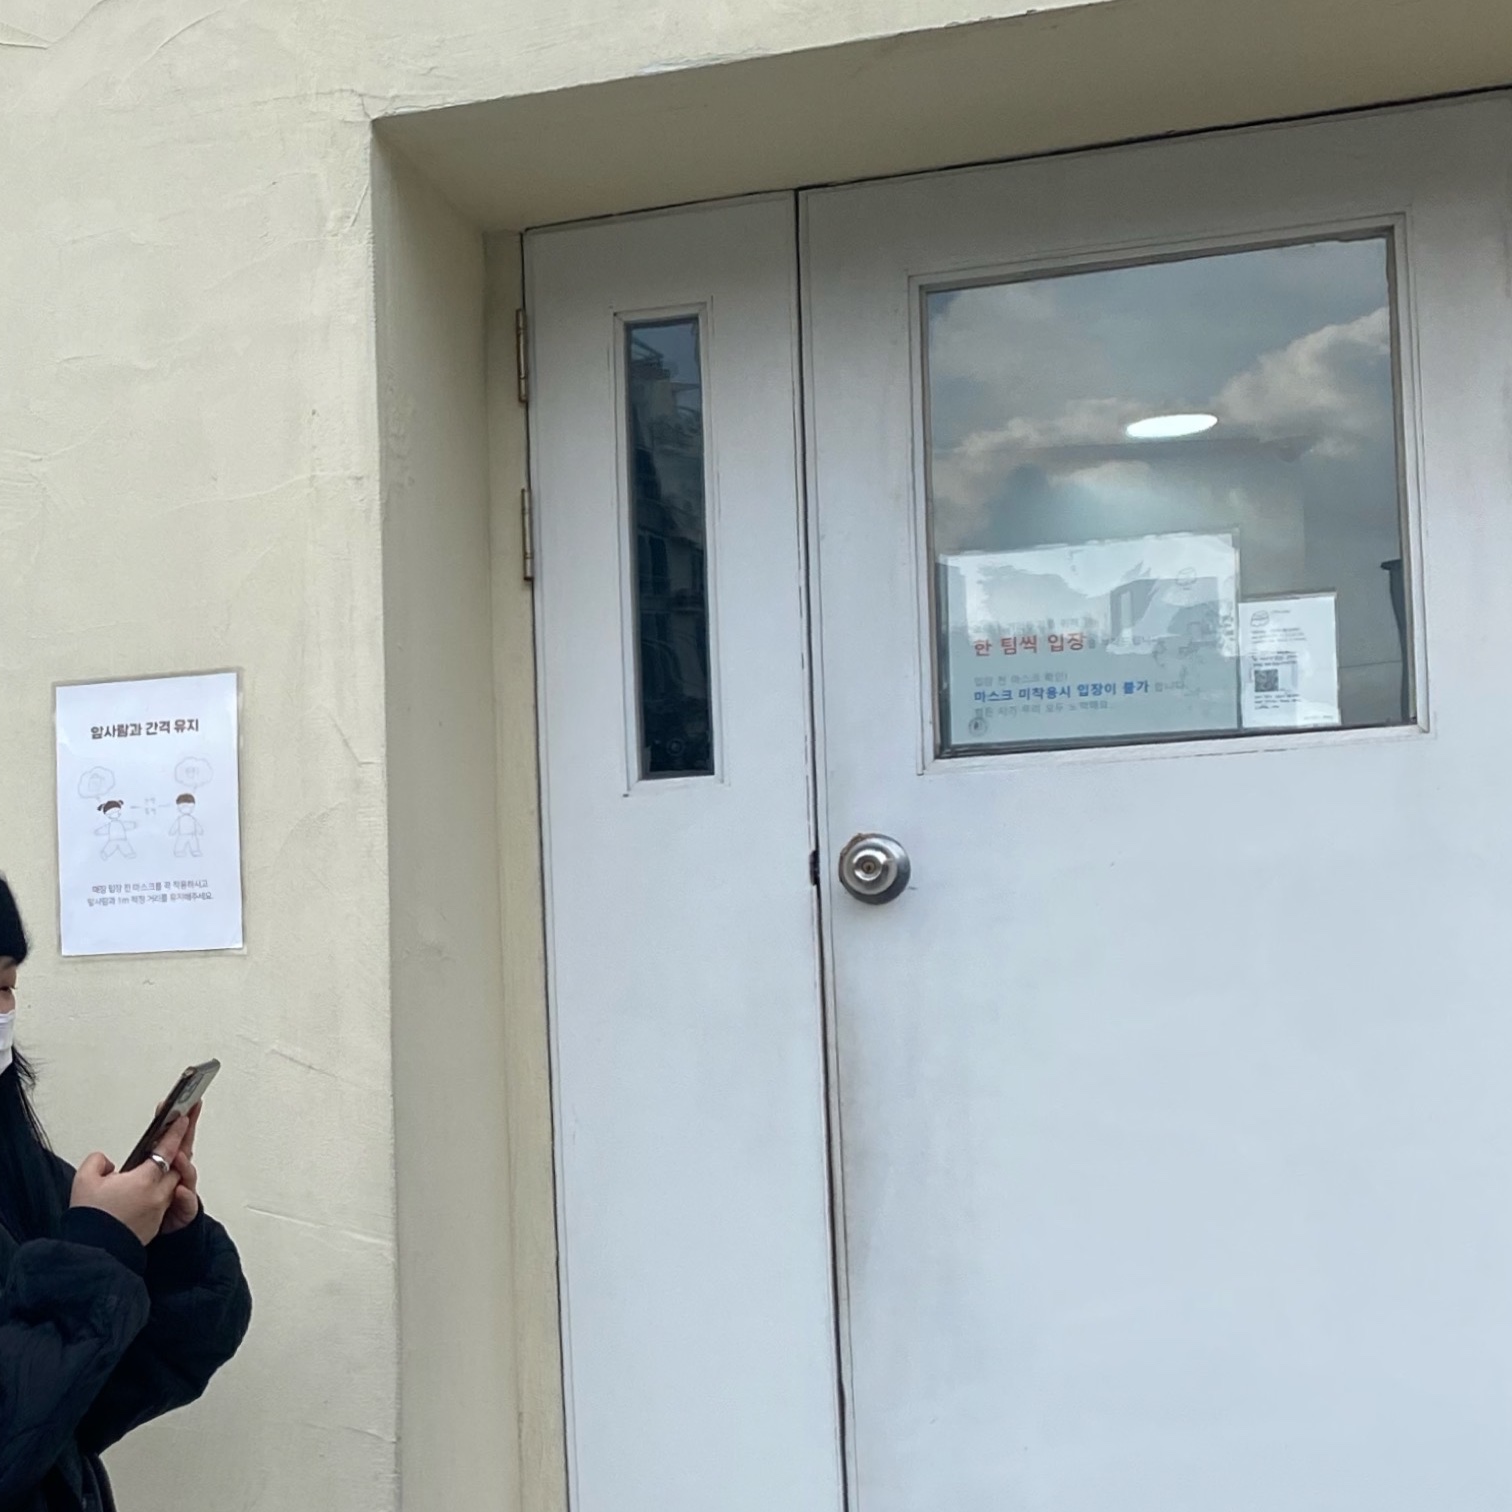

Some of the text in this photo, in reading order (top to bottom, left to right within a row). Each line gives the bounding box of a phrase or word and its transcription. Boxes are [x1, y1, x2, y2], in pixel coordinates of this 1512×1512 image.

[974, 640, 992, 657] 한
[1000, 635, 1037, 656] 팀씩
[973, 689, 1014, 703] 마스크
[1018, 685, 1071, 701] 미착용시
[1076, 681, 1117, 697] 입장이
[1123, 680, 1150, 695] 불가
[90, 718, 199, 740] 앞사람과 간격 유지
[132, 881, 162, 892] 마스크를
